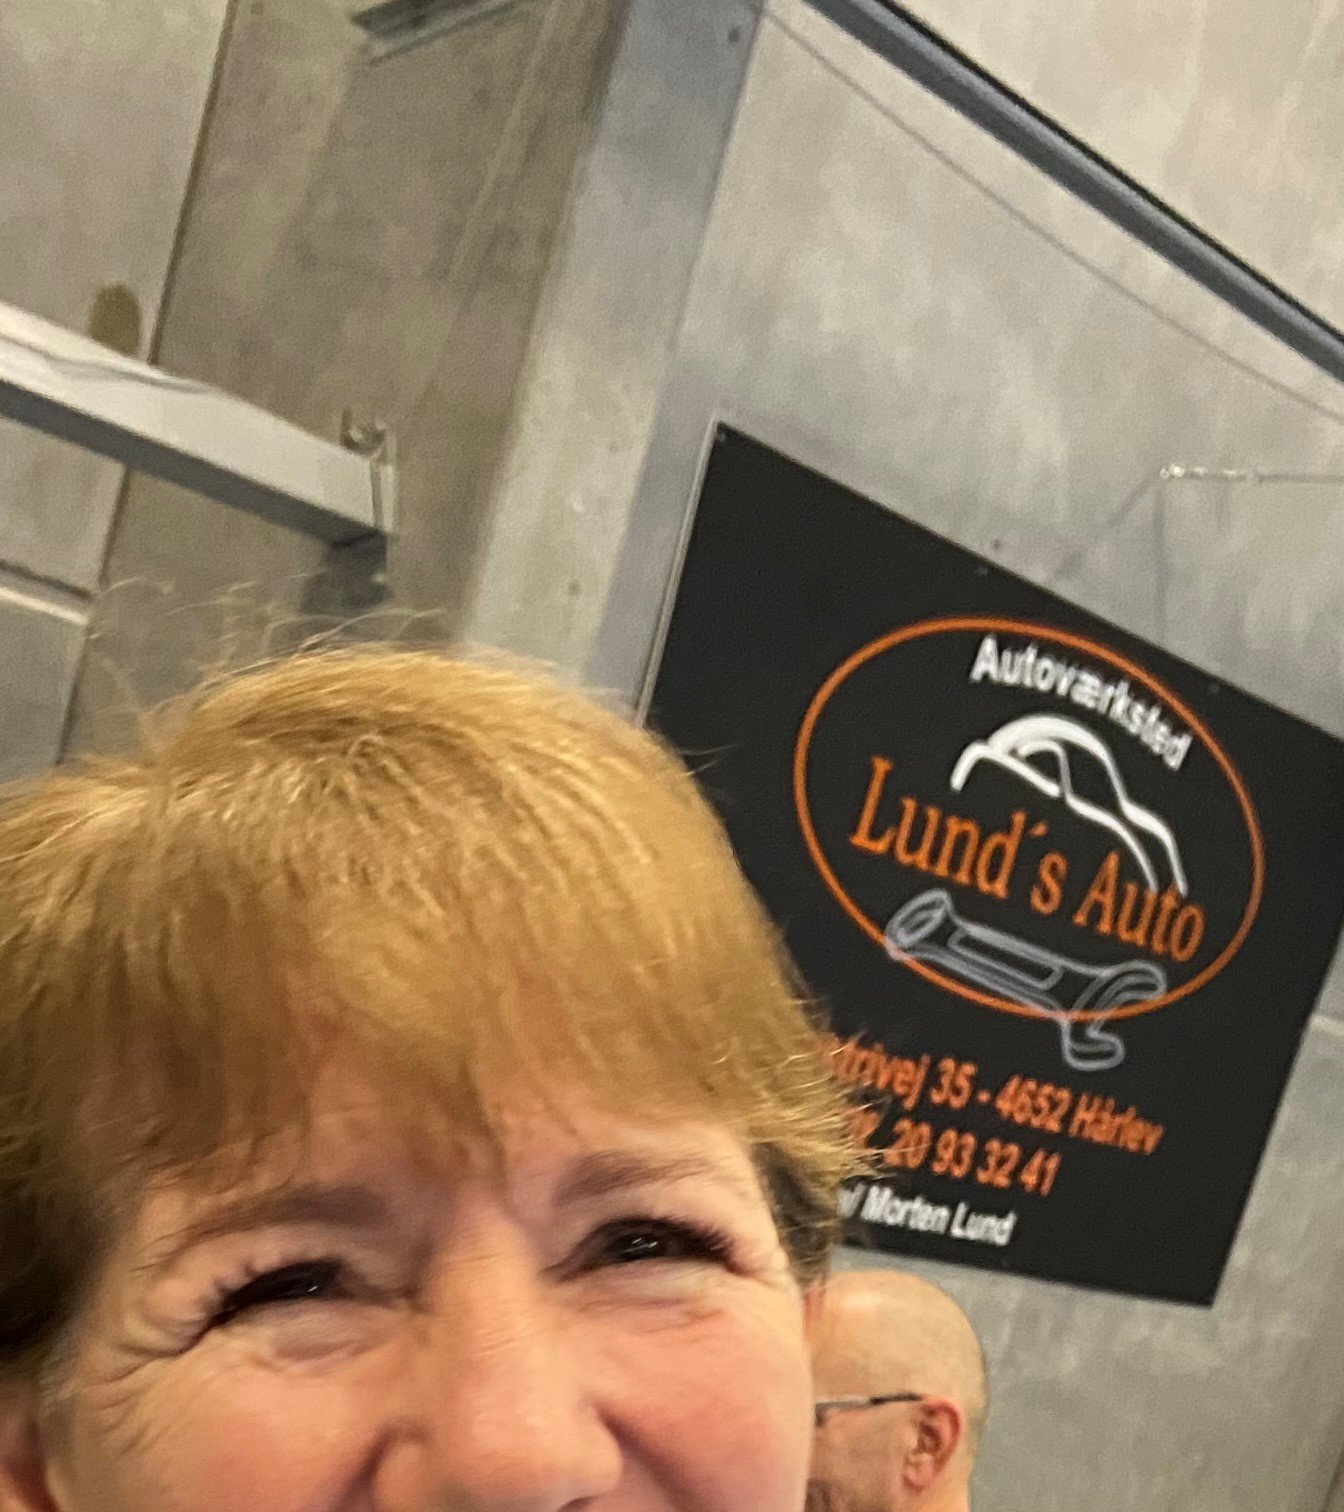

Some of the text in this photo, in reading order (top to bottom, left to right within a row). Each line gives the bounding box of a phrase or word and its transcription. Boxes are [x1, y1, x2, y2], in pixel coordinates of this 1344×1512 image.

[968, 634, 1193, 772] Autoværksted
[1072, 851, 1204, 962] Auto
[929, 1057, 978, 1110] 35
[994, 1073, 1072, 1134] 4652
[883, 1117, 933, 1169] 20
[931, 1128, 977, 1179] 93
[975, 1138, 1022, 1189] 32
[1018, 1148, 1063, 1197] 41
[860, 1185, 952, 1235] Morten
[951, 1201, 1017, 1246] Lund
